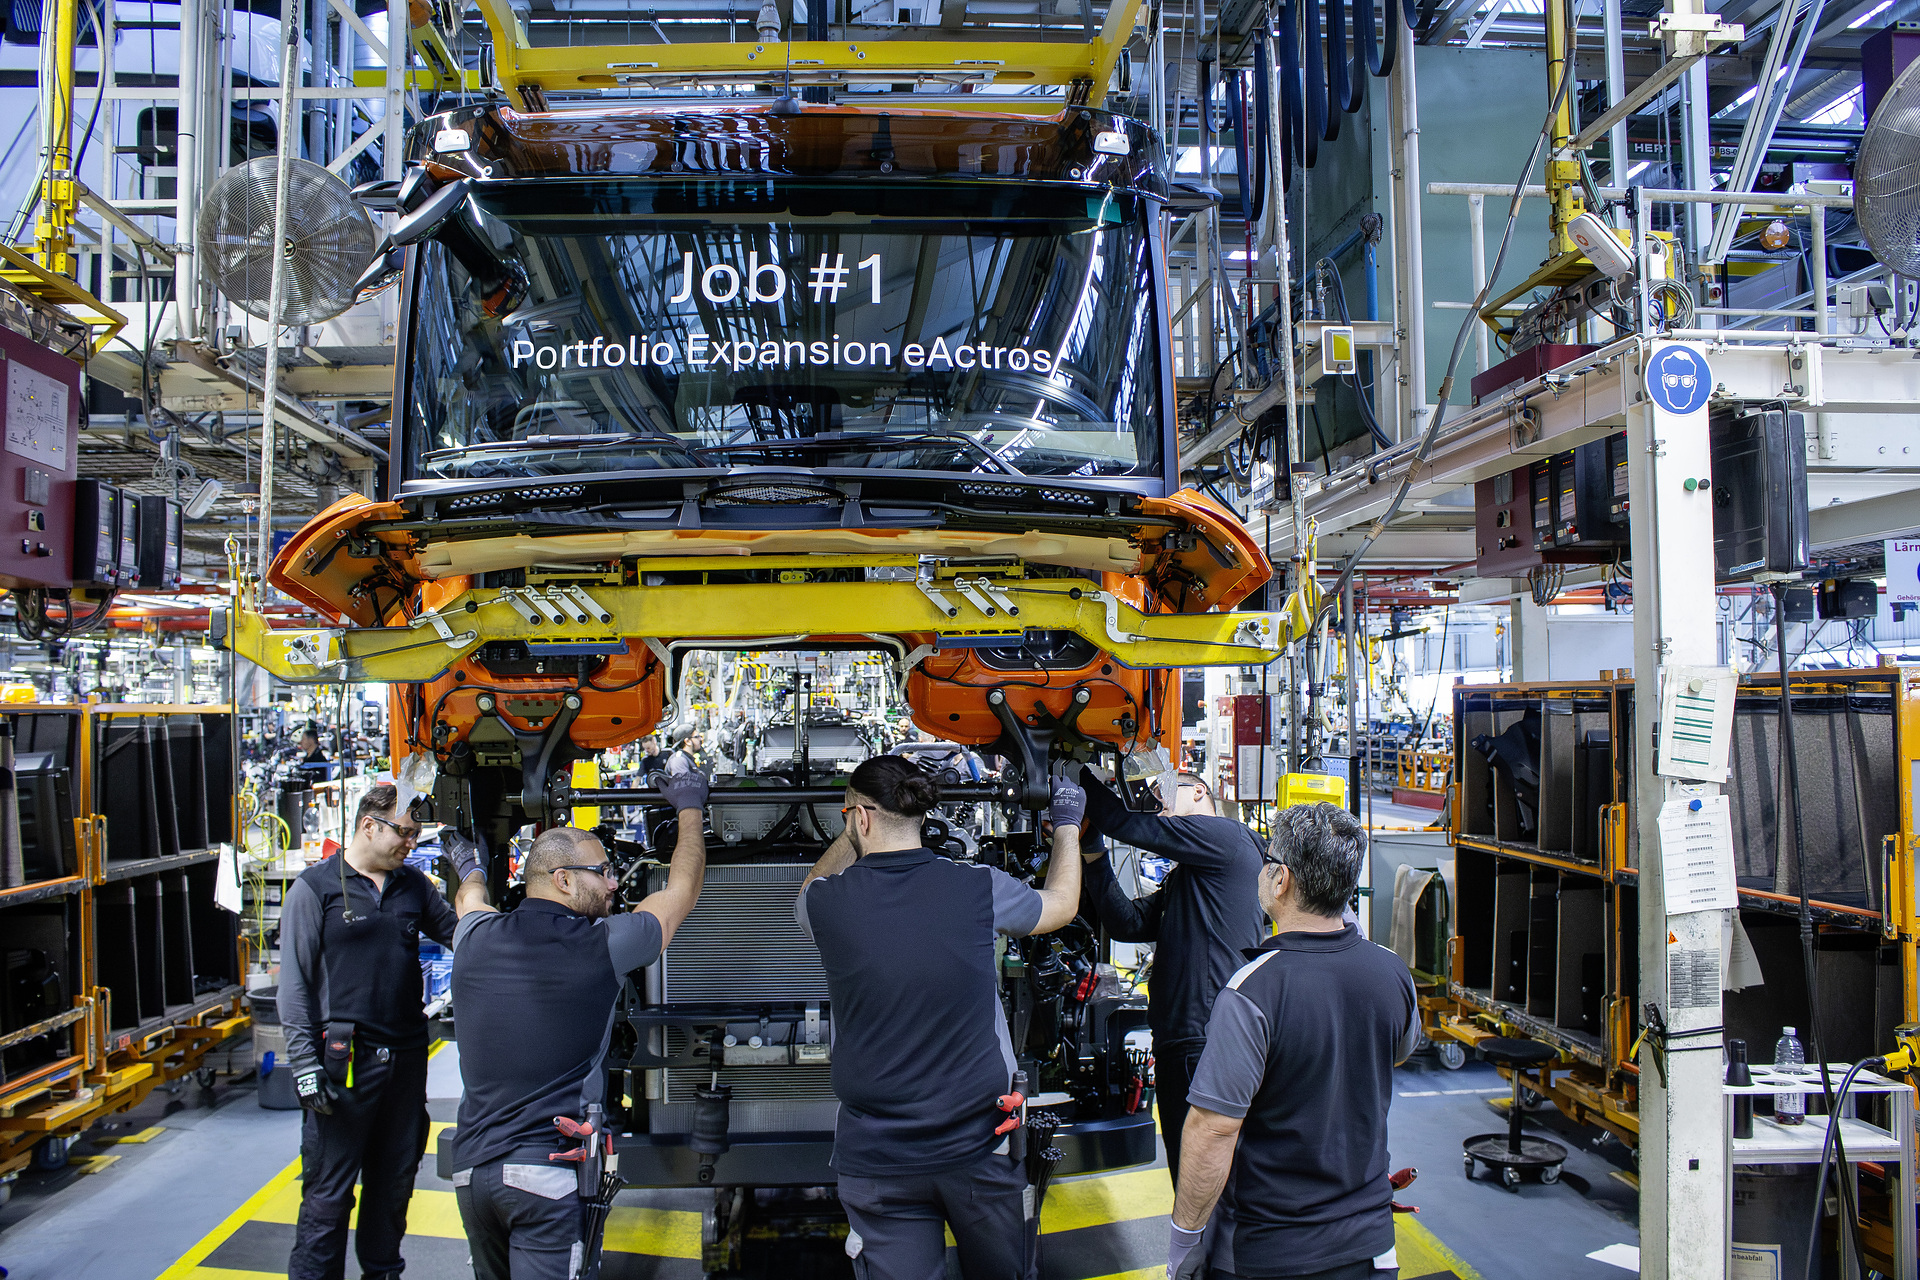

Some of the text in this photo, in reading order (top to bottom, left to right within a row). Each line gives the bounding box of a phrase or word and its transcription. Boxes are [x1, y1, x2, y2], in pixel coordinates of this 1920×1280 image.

[670, 250, 881, 304] Job #1
[513, 333, 1052, 373] Portfolio Expansion eActros
